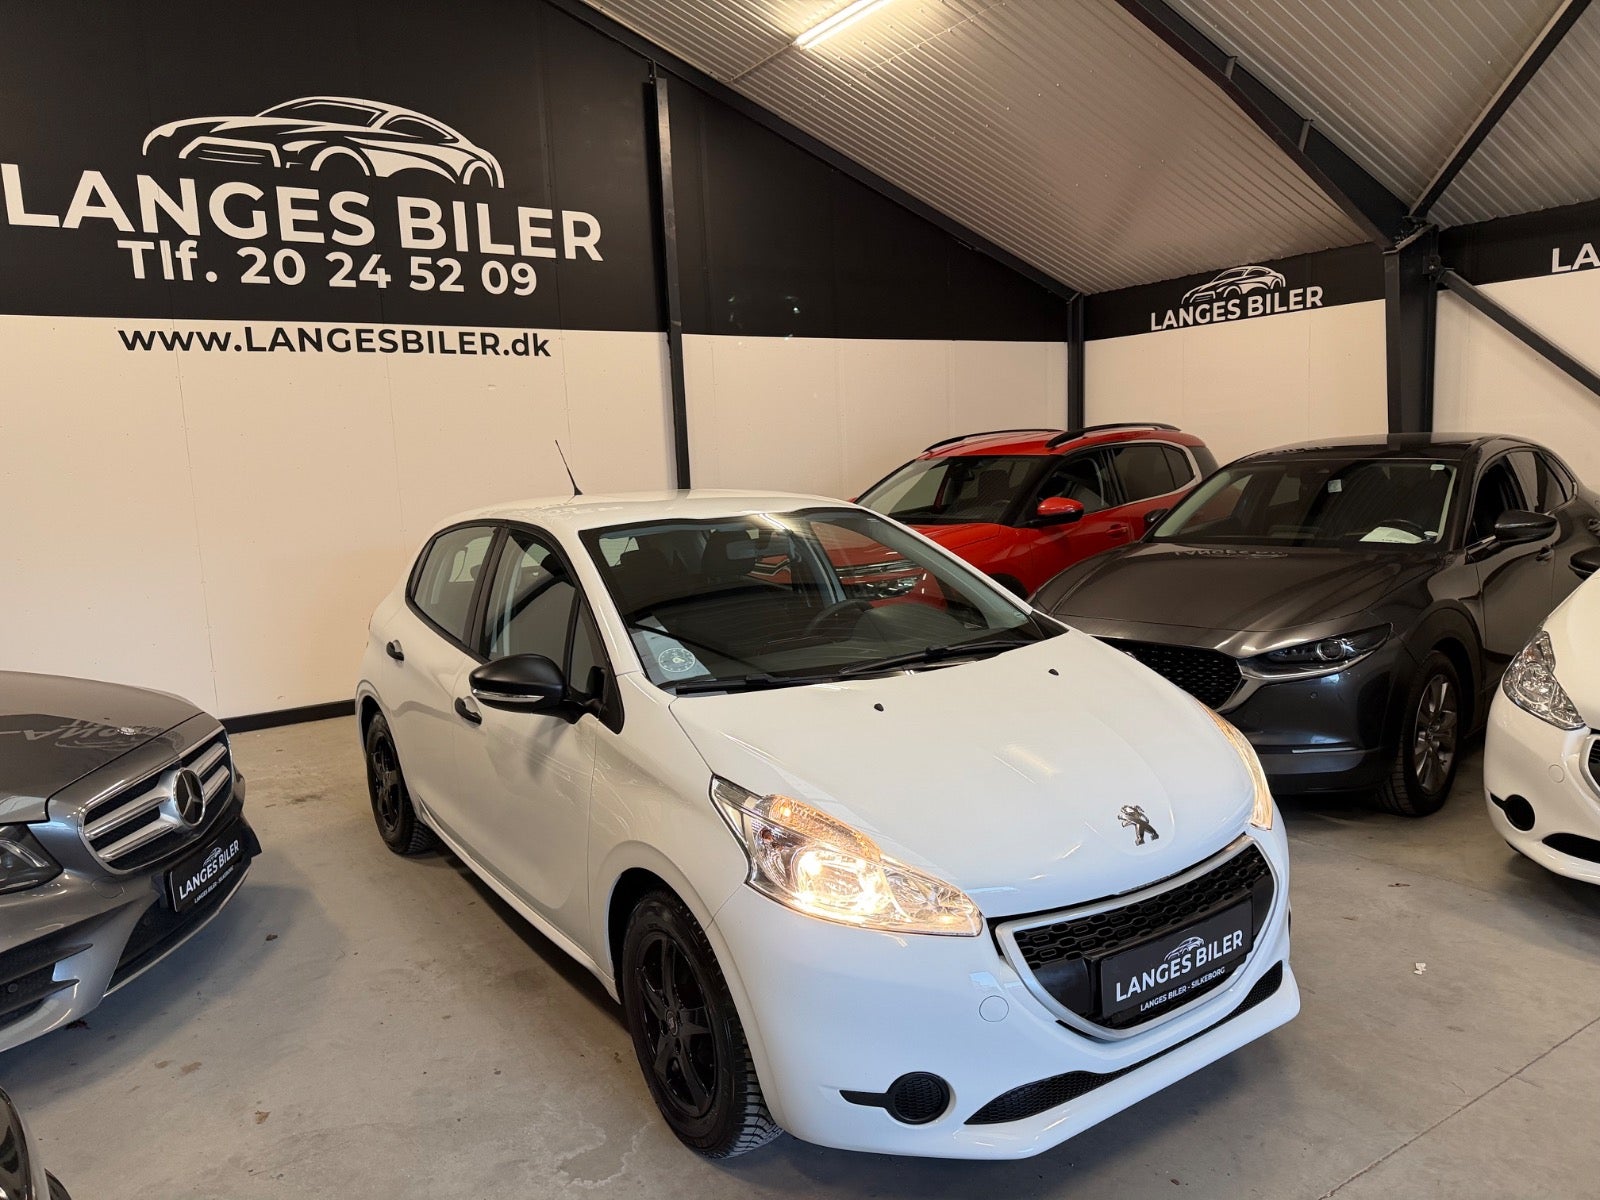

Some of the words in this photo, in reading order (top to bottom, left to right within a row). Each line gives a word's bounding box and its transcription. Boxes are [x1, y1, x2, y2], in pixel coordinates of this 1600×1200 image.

[0, 163, 376, 247] LANGES
[397, 195, 604, 262] BILER
[117, 239, 218, 283] Tlf.
[236, 246, 306, 286] 20
[325, 251, 392, 289] 24
[409, 255, 465, 293] 52
[481, 260, 537, 296] 09
[1151, 298, 1241, 331] LANGES
[1247, 286, 1324, 317] BILER
[117, 326, 551, 357] www.LANGESBILER.dk
[179, 859, 218, 900] LANGES
[219, 839, 239, 868] BILER
[1116, 953, 1192, 1002] LANGES
[1196, 930, 1243, 967] BILER
[1140, 994, 1167, 1012] LANGES
[1168, 985, 1187, 1000] BILER
[1191, 967, 1225, 989] SILKEBORG
